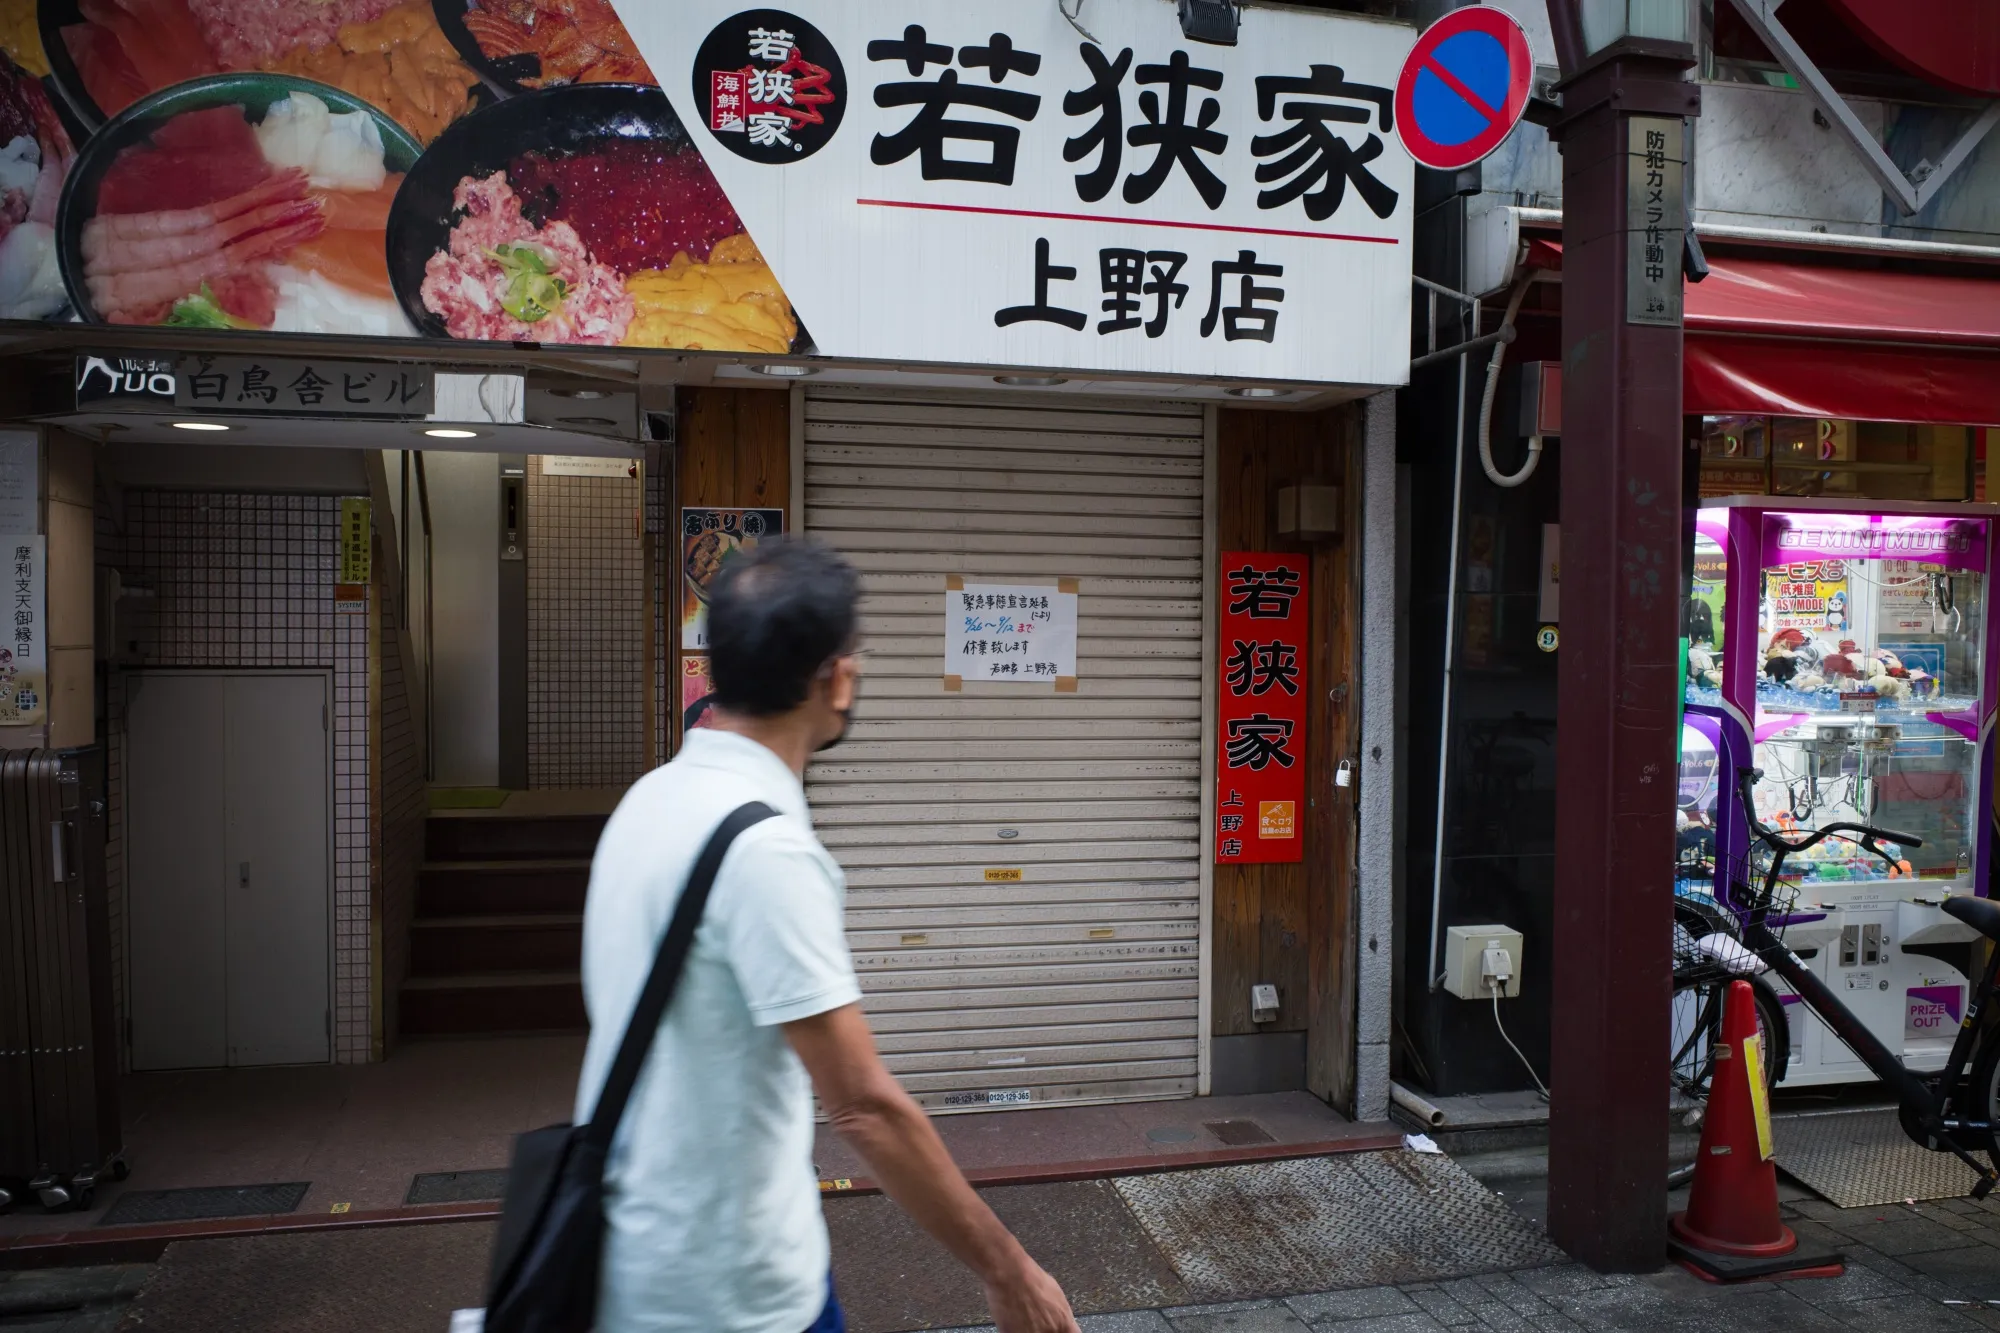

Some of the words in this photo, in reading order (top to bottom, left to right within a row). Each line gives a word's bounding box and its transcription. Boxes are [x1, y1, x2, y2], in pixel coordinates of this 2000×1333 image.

[748, 27, 795, 148] 若狭家
[867, 24, 1398, 221] 若狭家
[1645, 130, 1665, 283] 防犯カメラ作動中
[995, 237, 1285, 344] 上野店
[1779, 527, 1883, 551] GEMINI
[1887, 528, 1970, 553] MULTI
[14, 546, 33, 657] 摩利支天御縁日
[962, 593, 1049, 611] 緊急事態宣言延長
[1796, 598, 1824, 611] MODE
[963, 640, 1029, 655] 休業致します
[1024, 662, 1058, 675] 上野店
[1225, 565, 1300, 772] 若狭家
[1220, 789, 1243, 856] 上野店
[1262, 816, 1292, 826] 食べログ
[1910, 1004, 1945, 1016] PRIZE
[1913, 1017, 1941, 1028] OUT
[945, 1094, 986, 1105] 0120-129-365
[990, 1092, 1030, 1102] 0120-129-365
